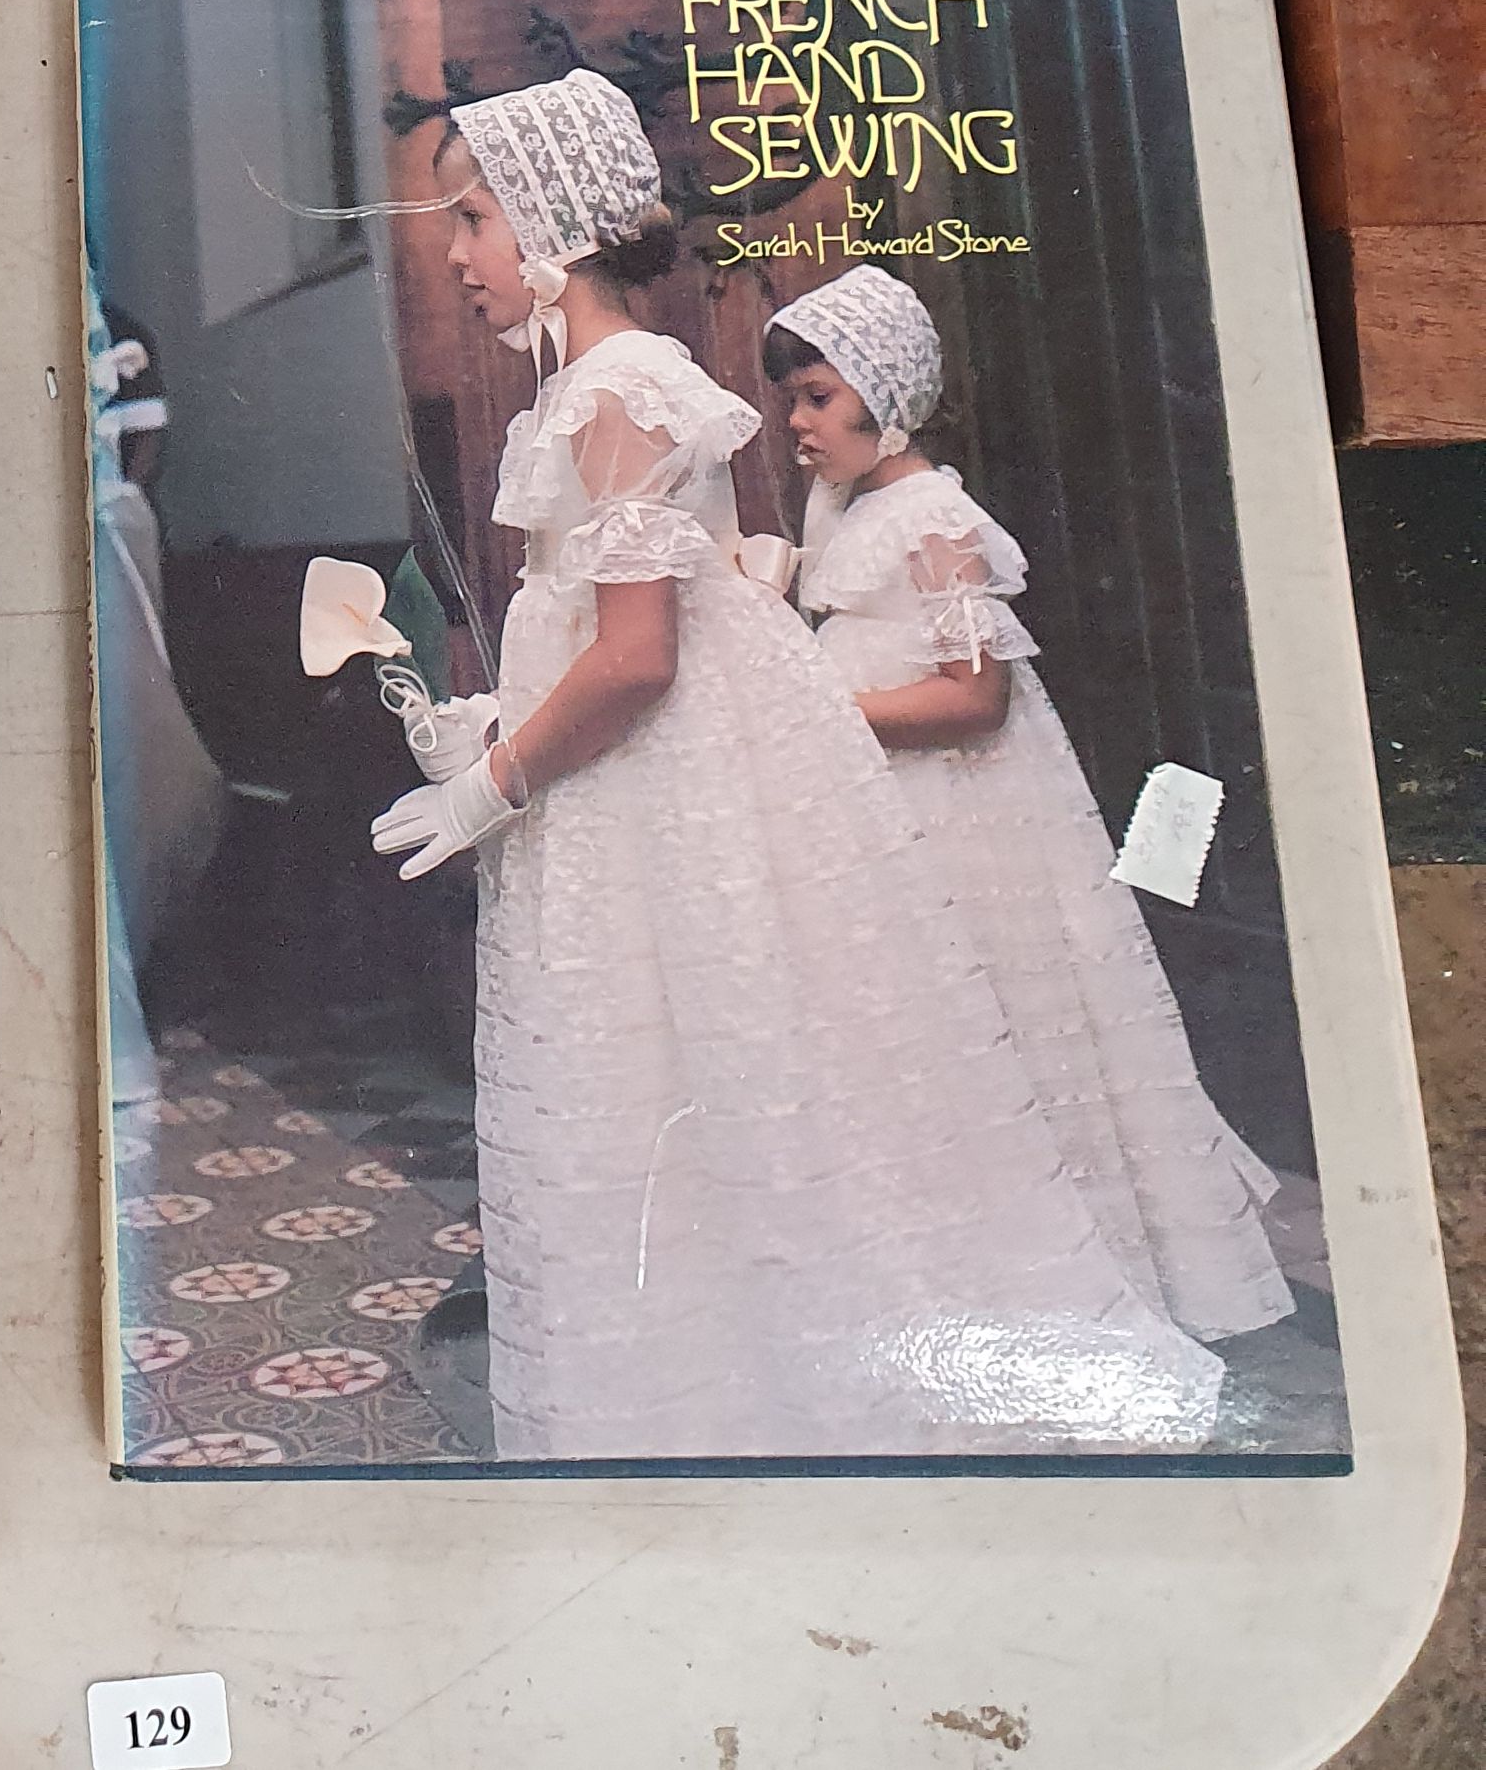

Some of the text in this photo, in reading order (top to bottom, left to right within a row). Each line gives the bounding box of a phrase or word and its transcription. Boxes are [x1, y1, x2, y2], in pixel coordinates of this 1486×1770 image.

[683, 39, 926, 124] HAND
[709, 110, 1018, 196] SEWING
[844, 185, 885, 230] by
[716, 219, 1031, 266] Sarah Howard Stone
[124, 1705, 193, 1750] 129
